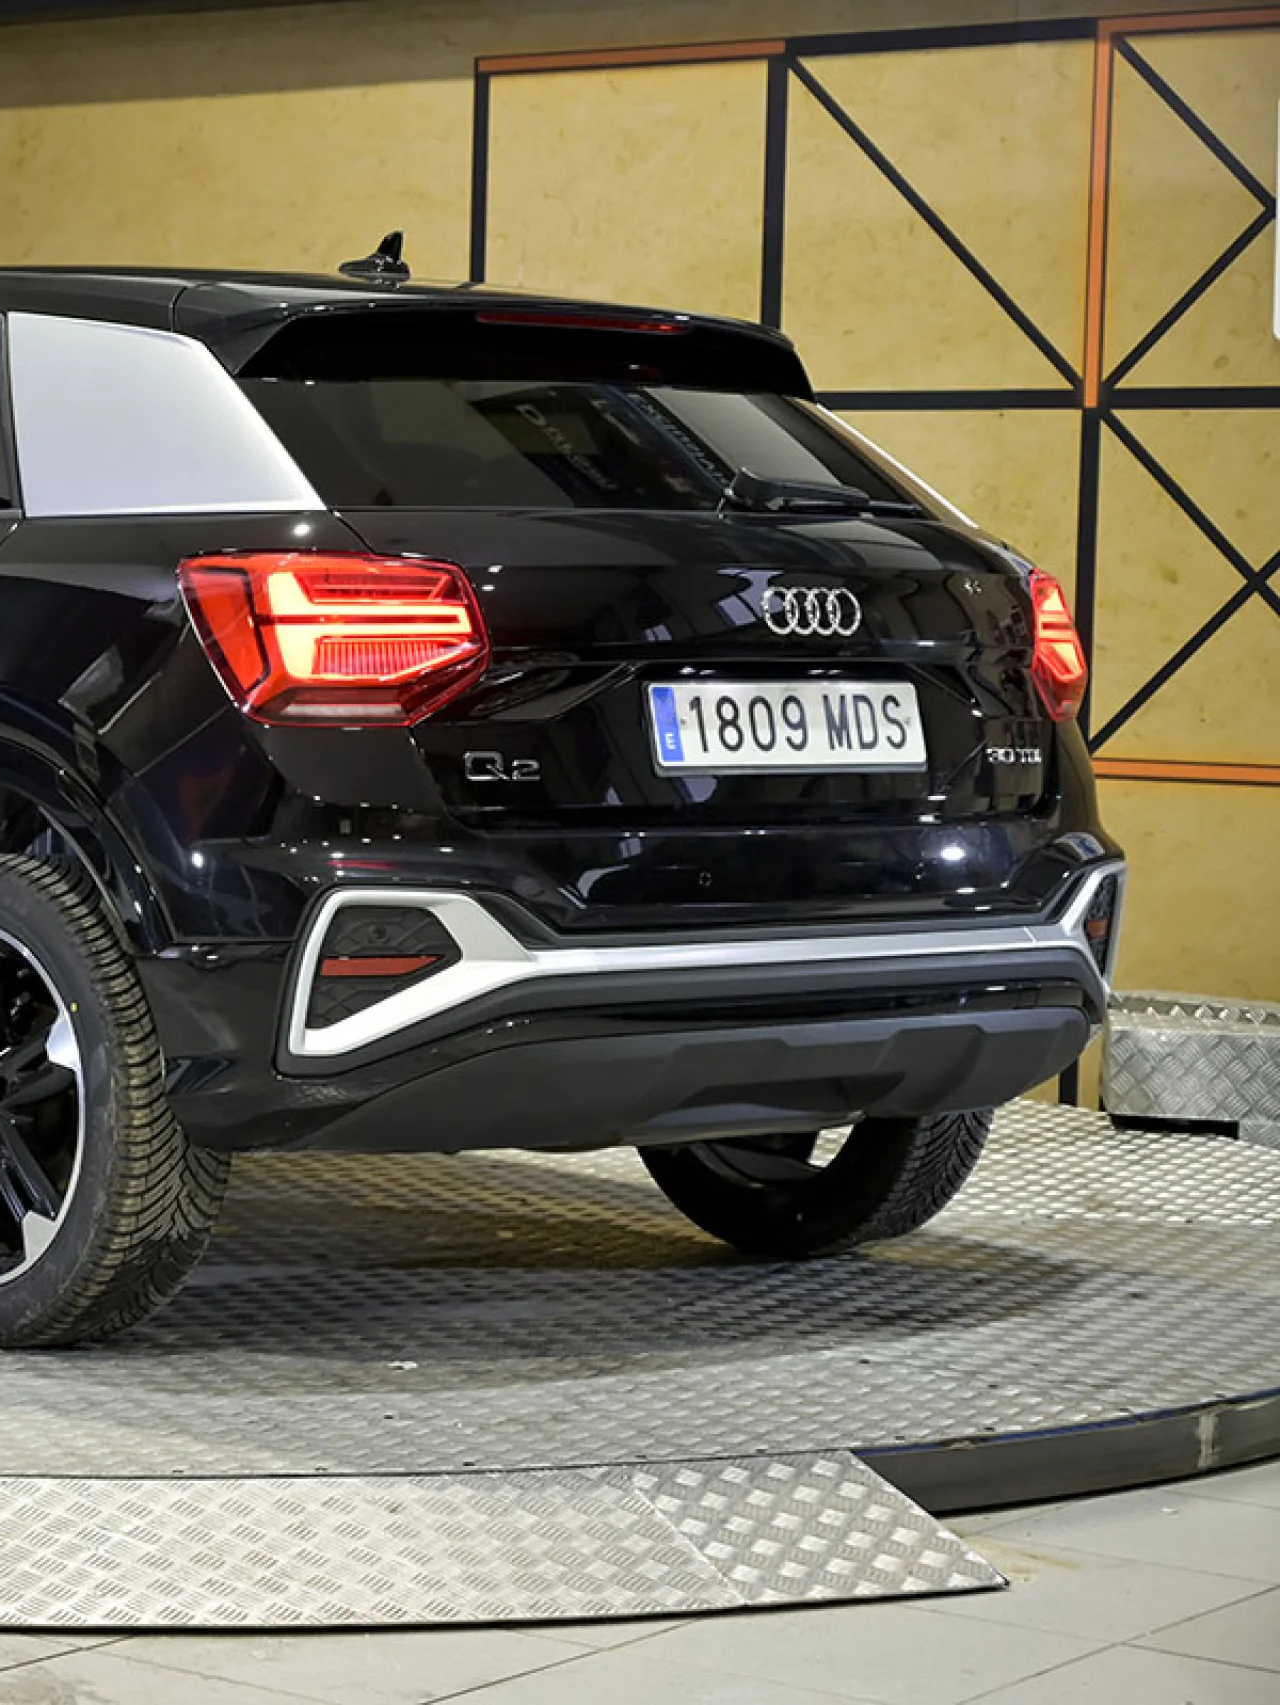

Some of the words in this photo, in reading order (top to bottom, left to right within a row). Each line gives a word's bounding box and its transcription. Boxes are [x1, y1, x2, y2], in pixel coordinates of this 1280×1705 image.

[688, 694, 808, 754] 1809
[821, 692, 907, 751] MDS
[664, 731, 677, 751] E
[464, 750, 541, 781] Q2
